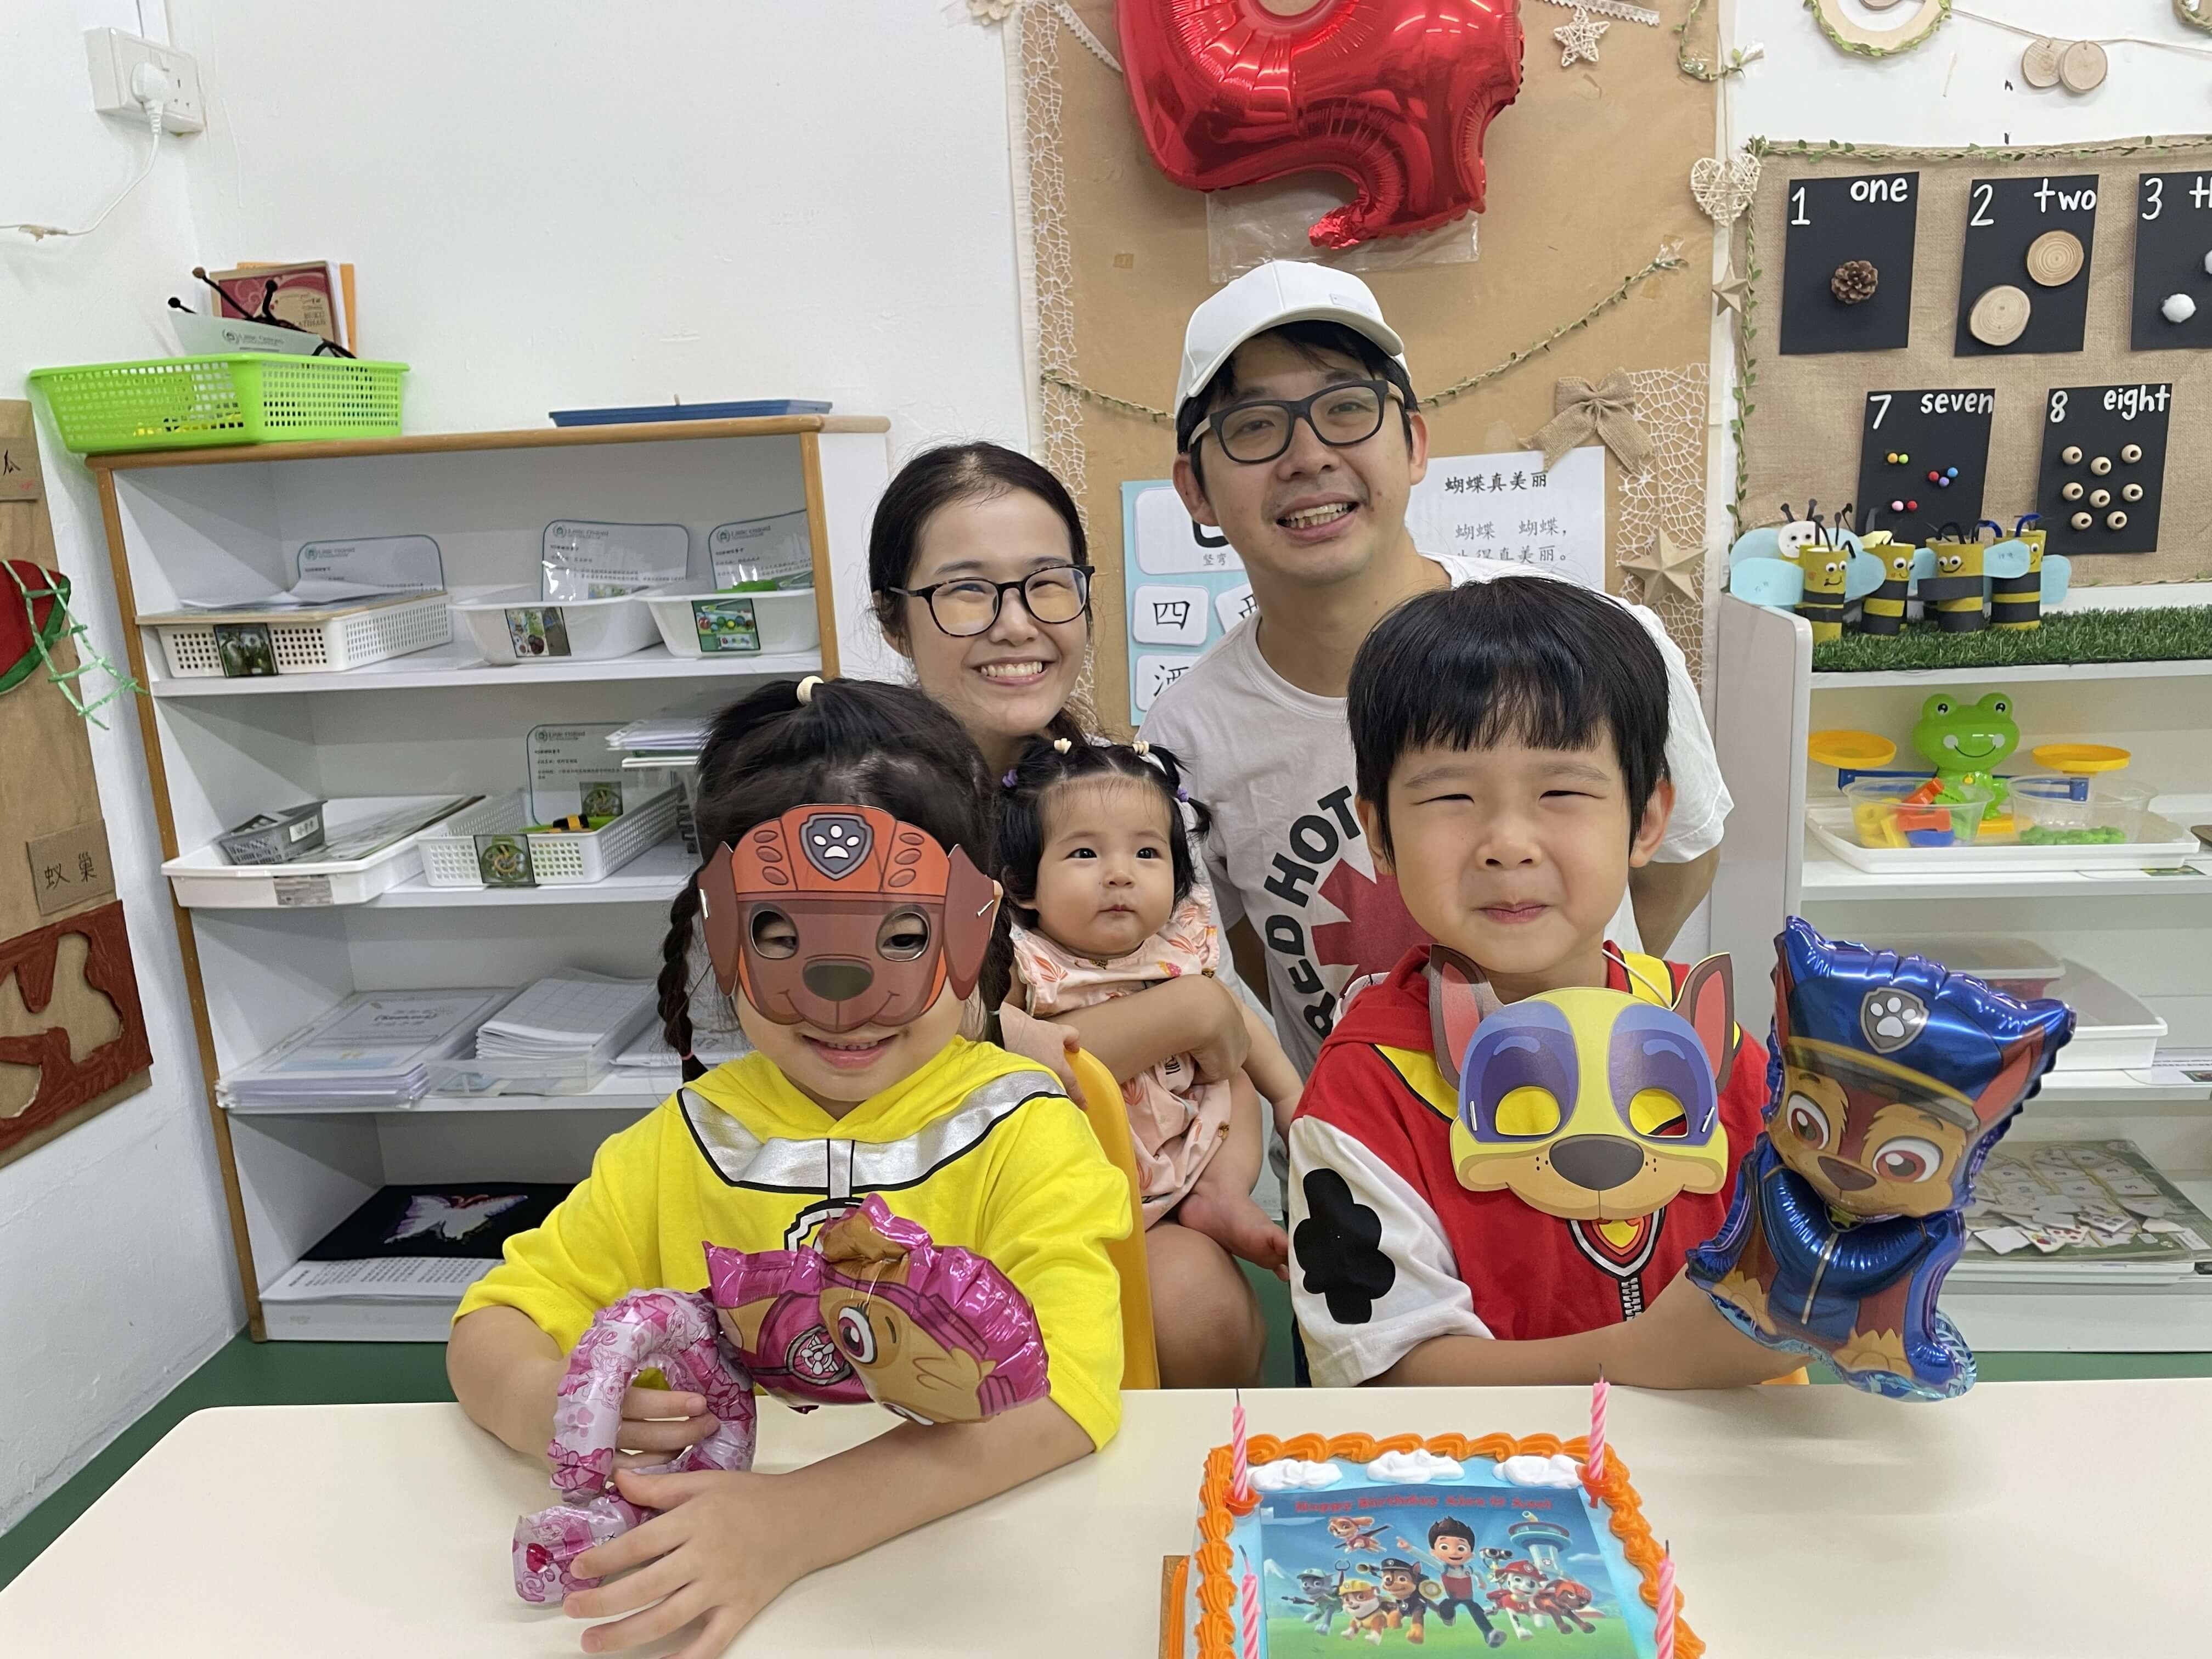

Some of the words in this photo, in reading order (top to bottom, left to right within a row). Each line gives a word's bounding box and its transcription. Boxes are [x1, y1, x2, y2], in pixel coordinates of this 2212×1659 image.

[1792, 187, 1810, 225] 1
[1850, 177, 1908, 202] one
[1970, 184, 1994, 226] 2
[2034, 178, 2097, 213] two
[2142, 178, 2163, 220] 3
[1870, 394, 1892, 430] 7
[1920, 392, 1994, 414] seven
[2050, 391, 2068, 422] 8
[2103, 385, 2170, 420] eight
[1444, 470, 1548, 494] 蝴蝶真美丽
[1455, 521, 1496, 540] 蝴蝶
[1153, 601, 1190, 630] 四
[1263, 785, 1361, 908] HOT
[1265, 915, 1336, 1042] RED
[1295, 1500, 1352, 1514] Happy
[1358, 1494, 1438, 1508] Birthday
